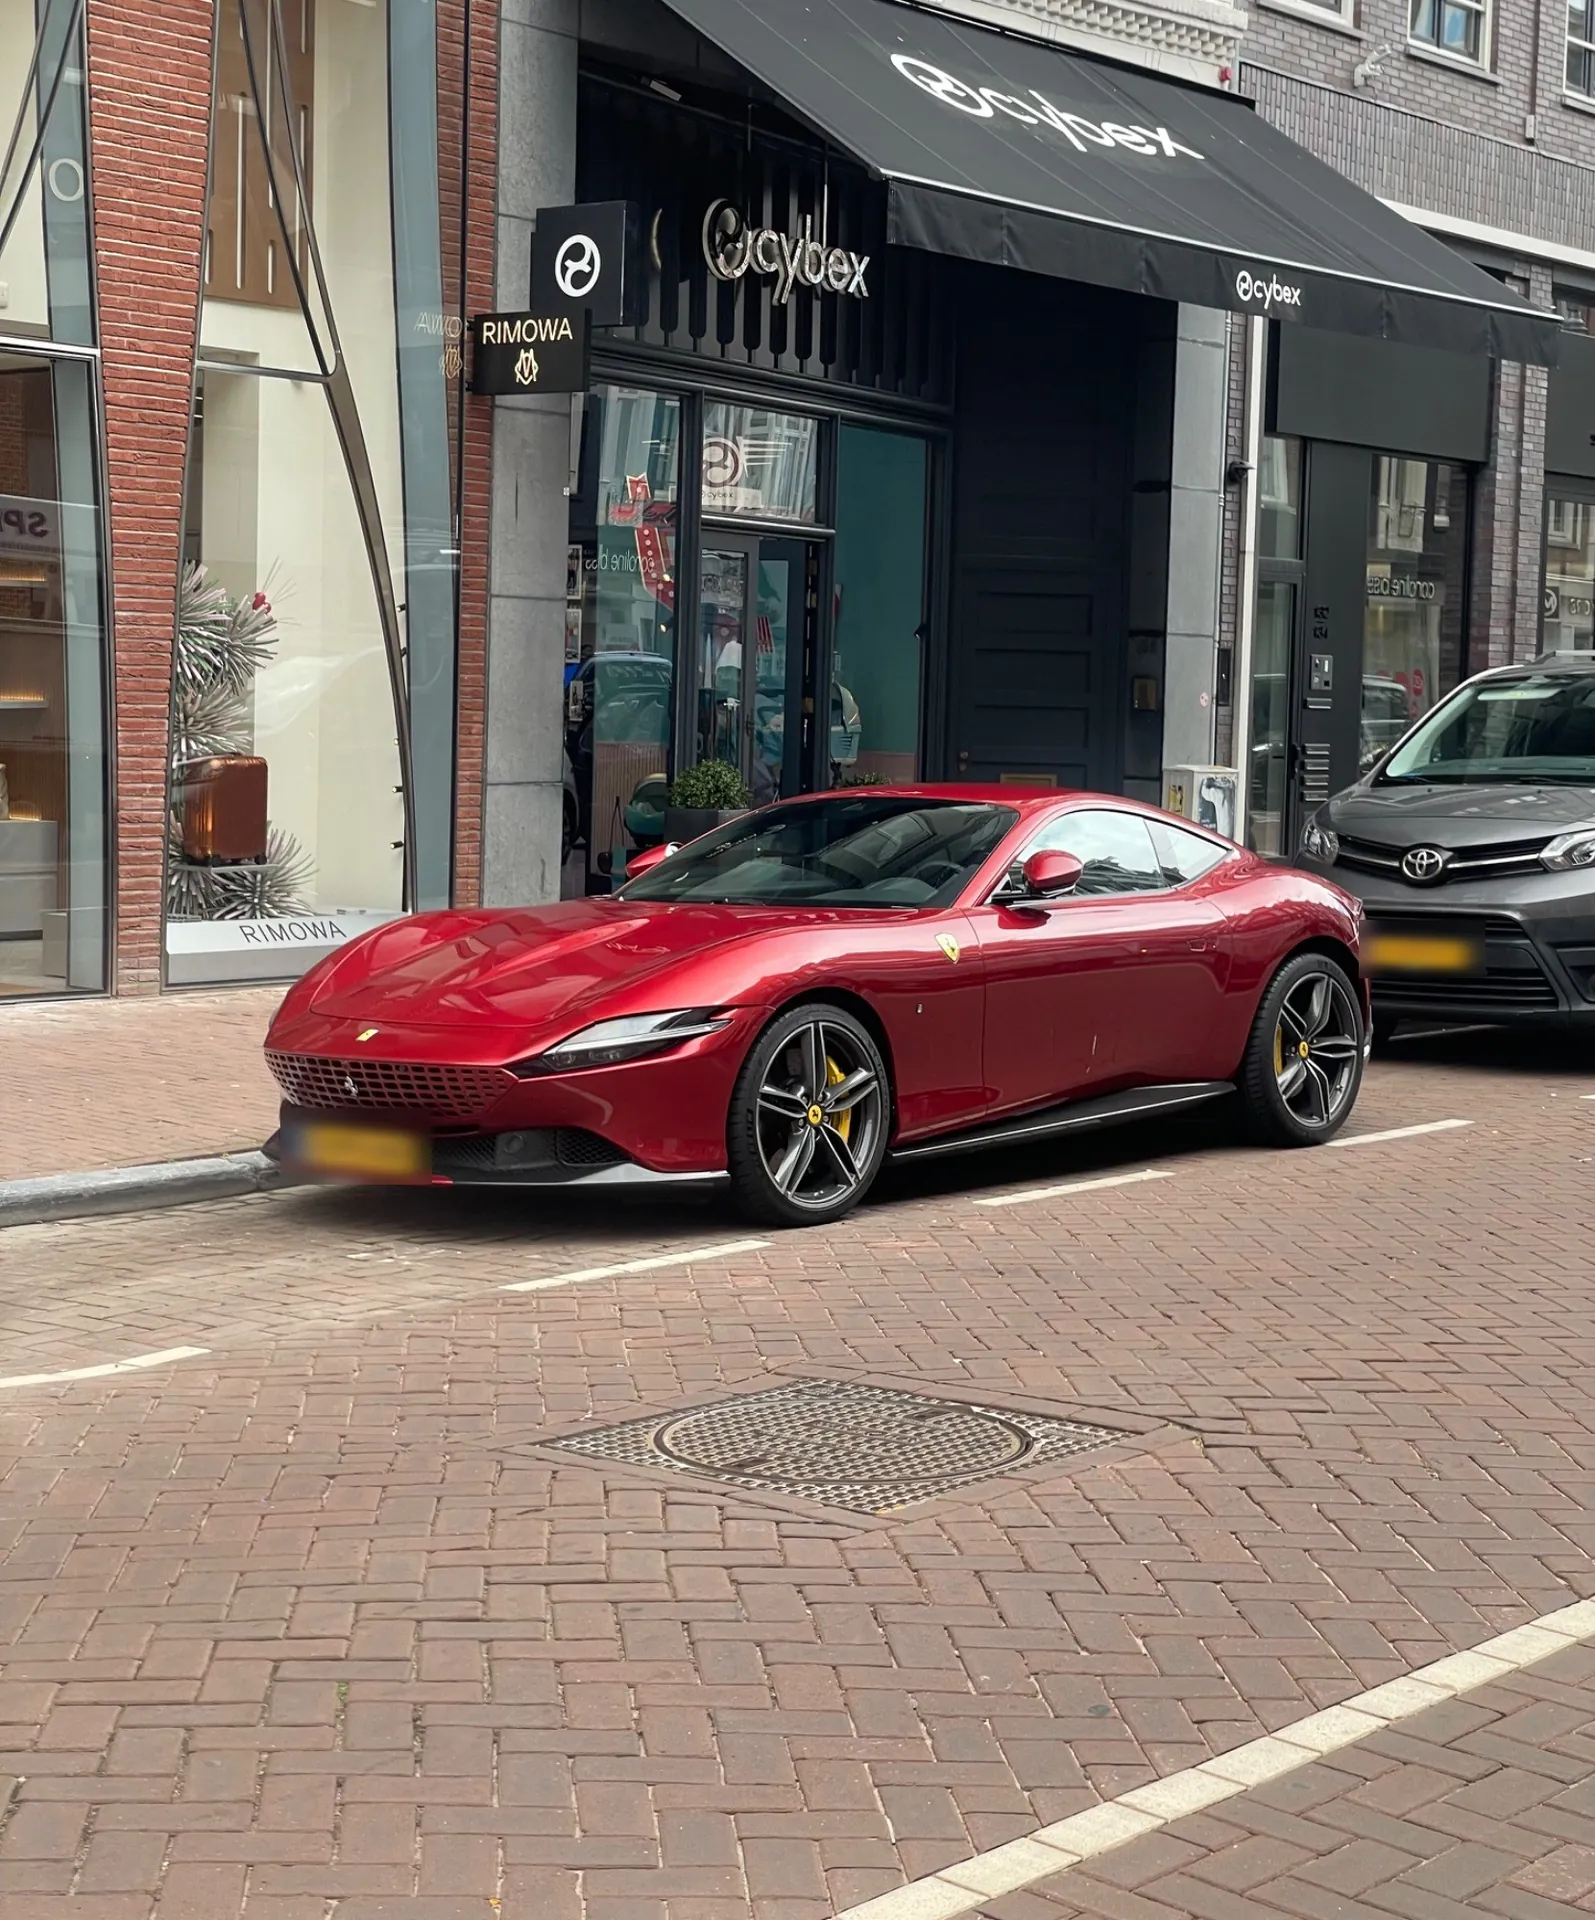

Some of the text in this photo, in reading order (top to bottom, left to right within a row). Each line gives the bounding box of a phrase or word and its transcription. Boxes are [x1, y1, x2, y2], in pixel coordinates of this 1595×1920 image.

[979, 87, 1205, 160] cybex
[751, 214, 870, 305] cybex
[1253, 273, 1302, 310] cybex
[482, 317, 573, 344] RIMOWA
[239, 920, 347, 943] RIMOWA
